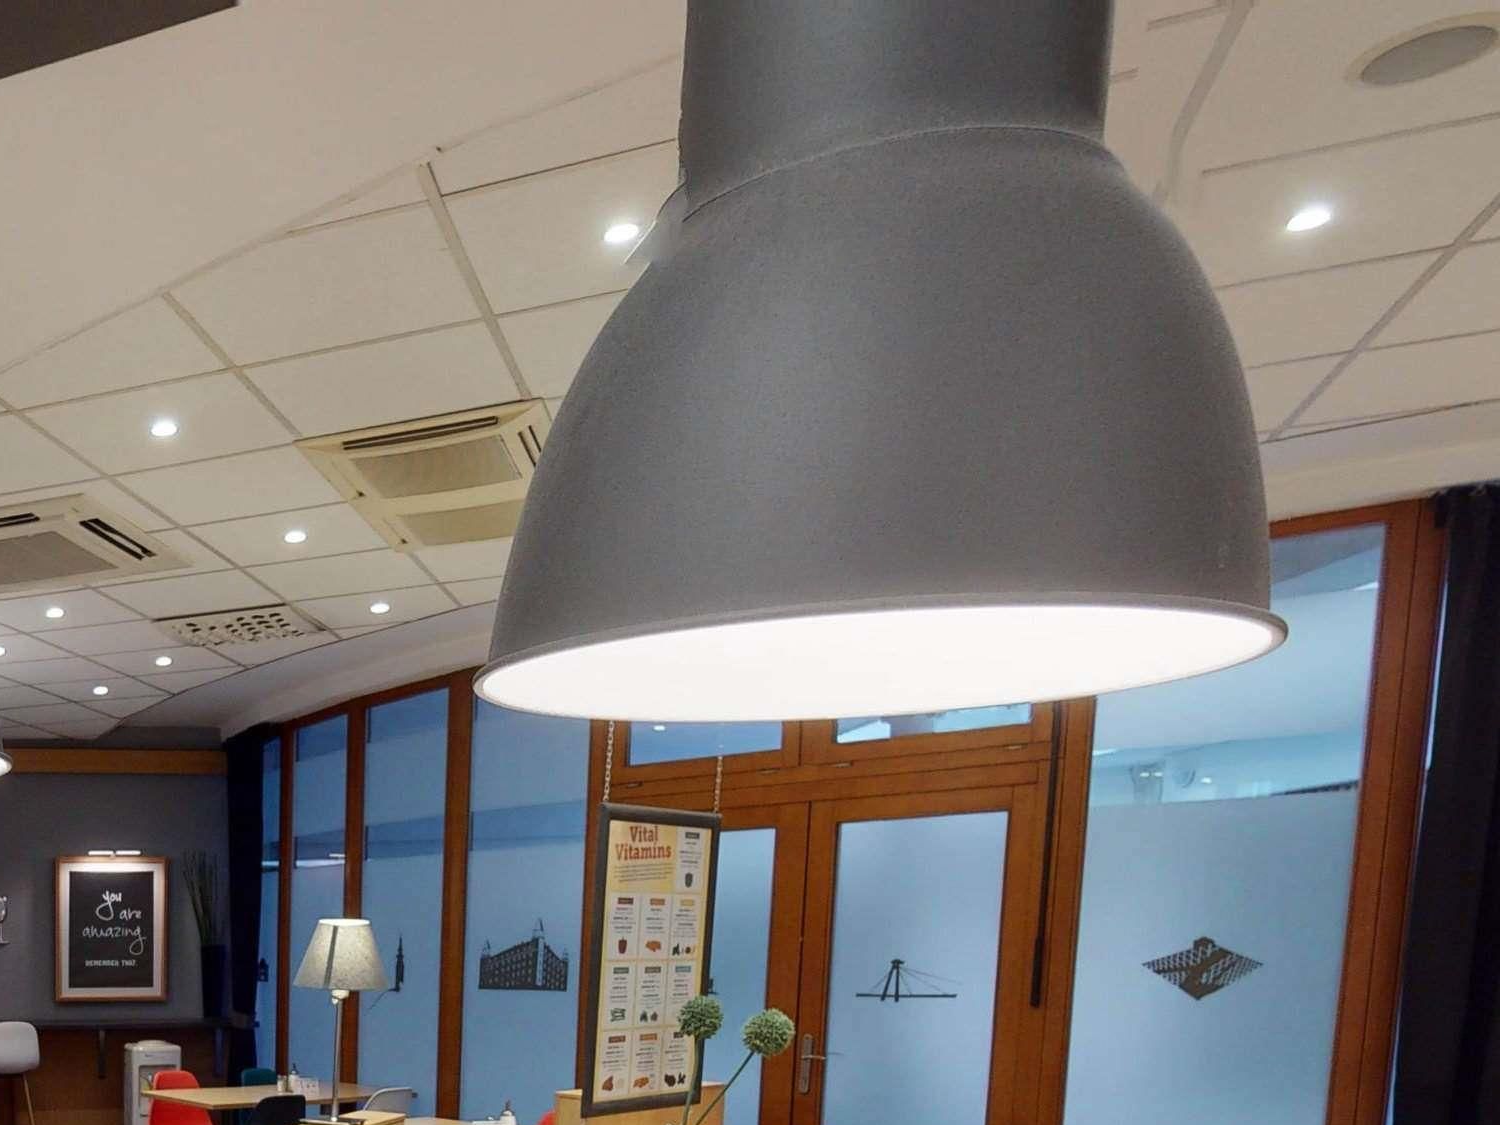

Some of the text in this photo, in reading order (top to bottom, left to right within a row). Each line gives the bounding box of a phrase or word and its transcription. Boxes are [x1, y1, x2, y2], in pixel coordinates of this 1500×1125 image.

[629, 826, 659, 843] Vital
[615, 843, 672, 861] Vitamins
[95, 890, 123, 921] you
[119, 908, 142, 921] are
[82, 925, 146, 956] amazing
